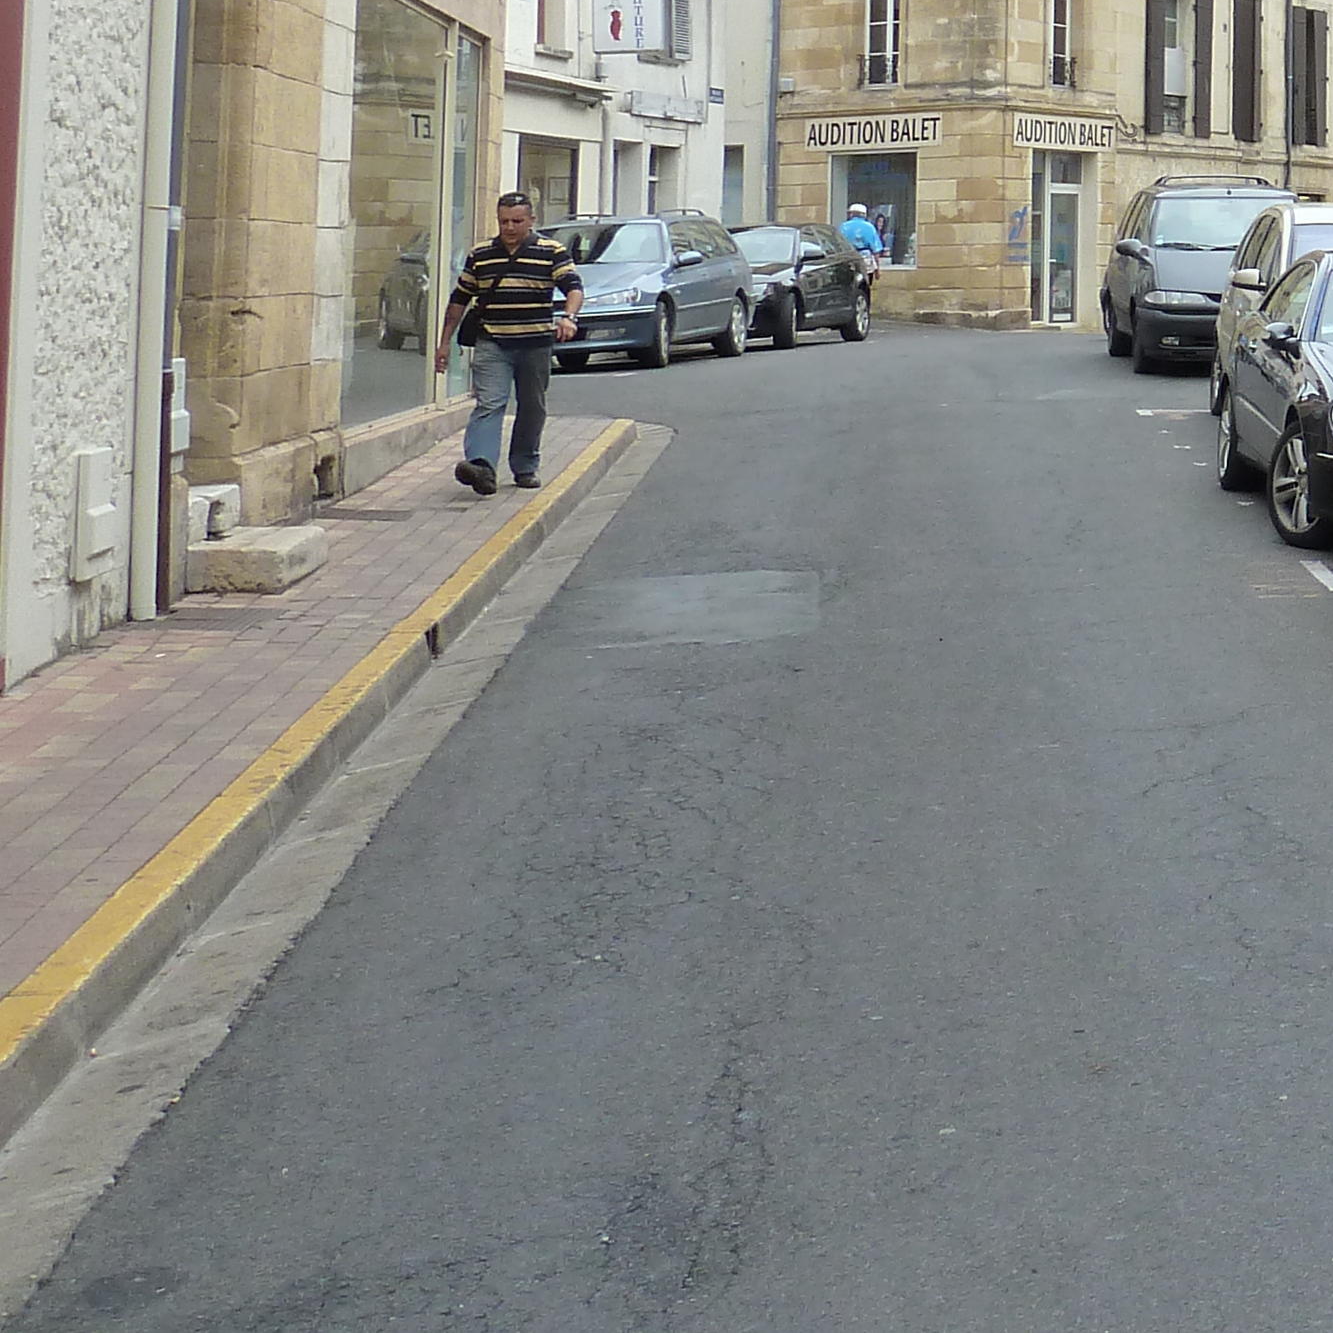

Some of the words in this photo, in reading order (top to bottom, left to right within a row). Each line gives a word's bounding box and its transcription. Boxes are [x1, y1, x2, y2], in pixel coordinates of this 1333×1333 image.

[807, 119, 886, 147] AUDITION
[890, 117, 941, 143] BALET
[1015, 118, 1077, 145] AUDITION
[1079, 123, 1114, 148] BALET
